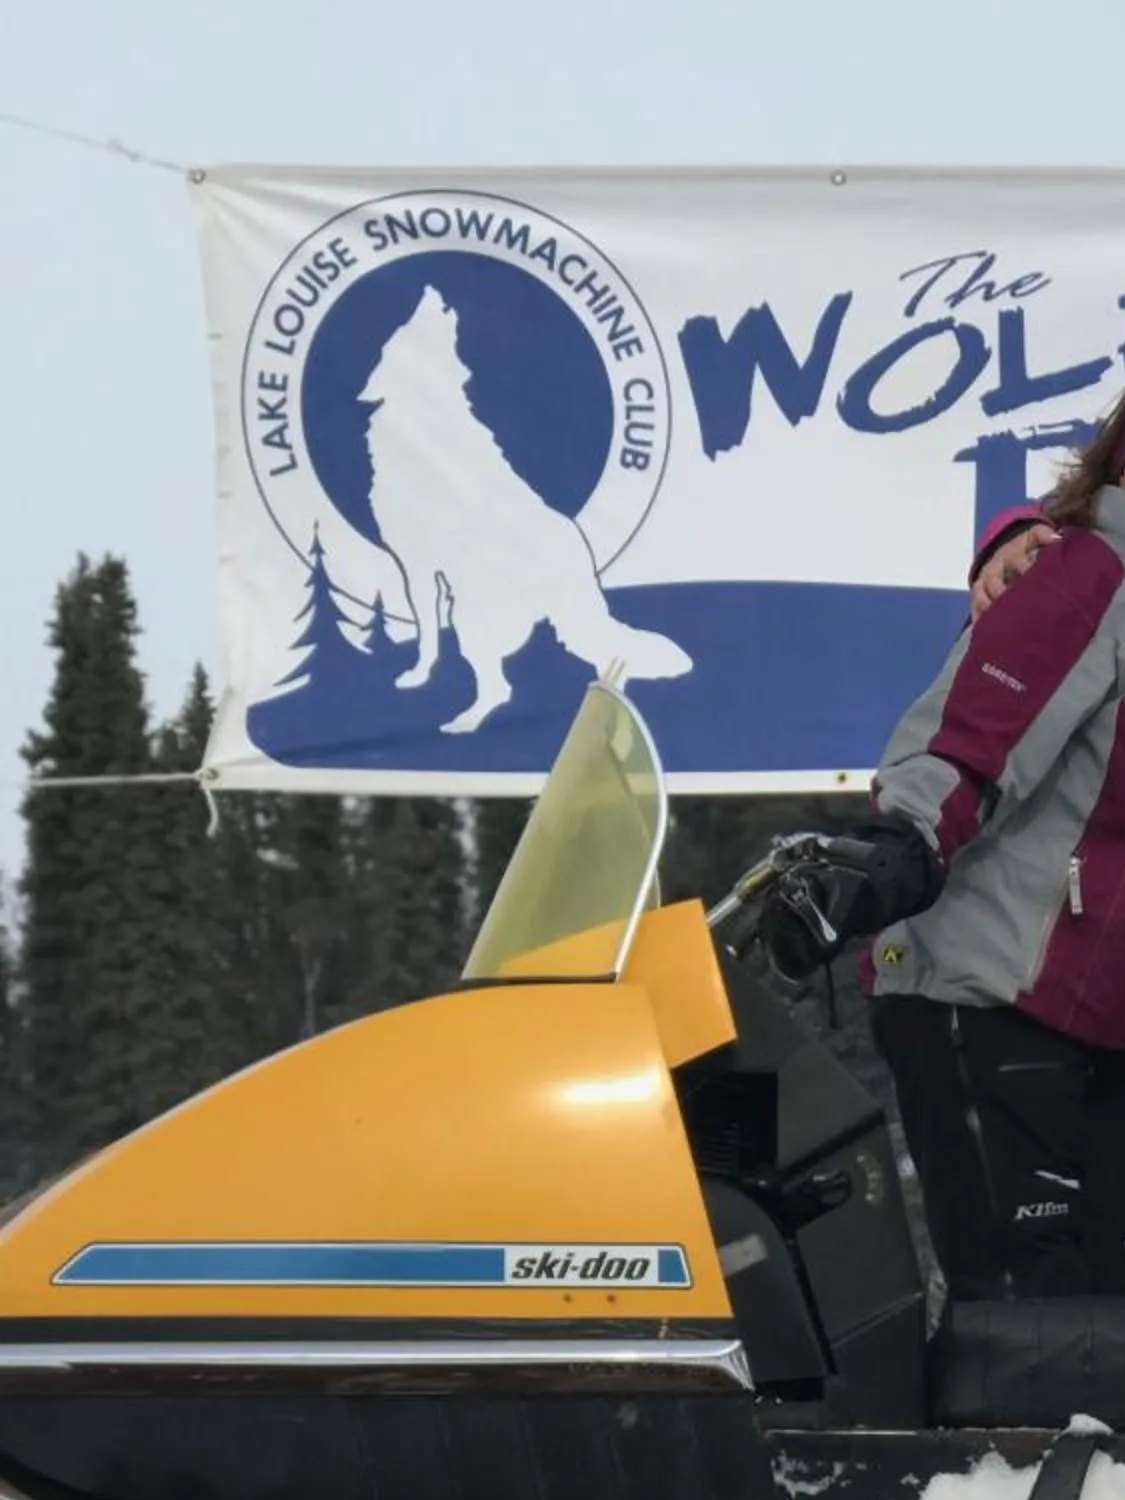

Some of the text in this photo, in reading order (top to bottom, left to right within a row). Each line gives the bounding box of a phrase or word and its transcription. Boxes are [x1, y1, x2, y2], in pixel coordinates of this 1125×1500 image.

[899, 250, 1053, 318] The
[257, 207, 655, 477] LAKE LOUISE SNOWMACHINE CLUB
[511, 1251, 651, 1281] ski-doo
